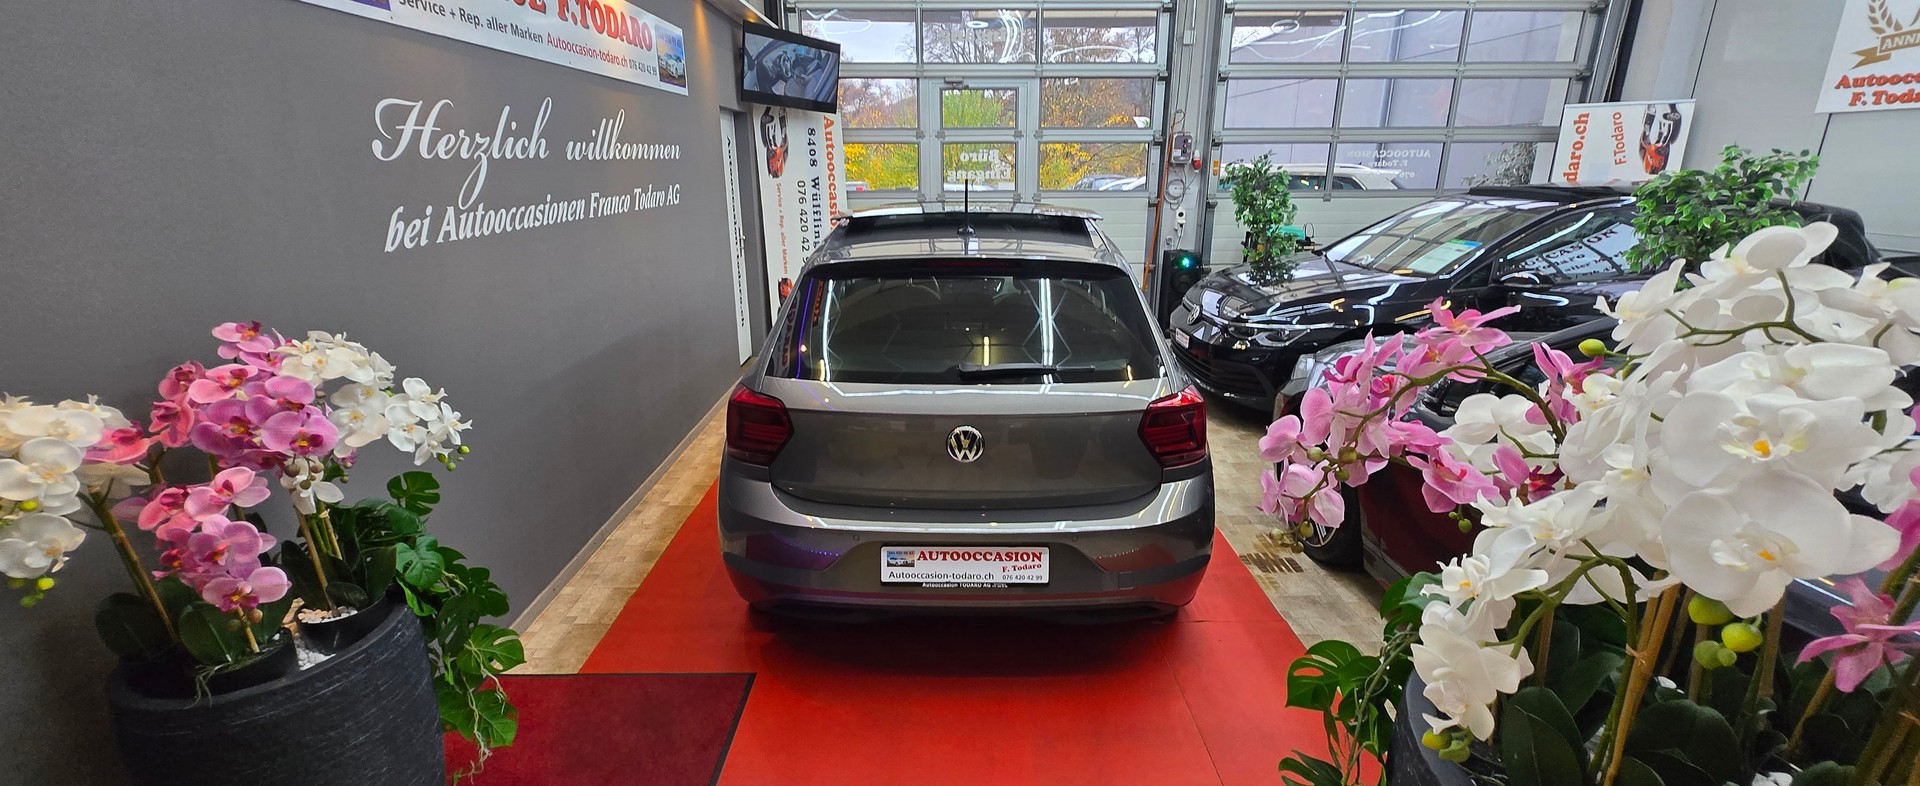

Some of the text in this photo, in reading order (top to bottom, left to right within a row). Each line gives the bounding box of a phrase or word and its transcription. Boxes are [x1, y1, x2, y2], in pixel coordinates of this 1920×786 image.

[459, 7, 484, 29] Rep.
[486, 16, 508, 34] aller
[510, 23, 543, 44] Marken
[547, 32, 628, 67] Autooccasion-todaro.ch
[1848, 91, 1867, 106] F.
[807, 127, 817, 168] 8408
[1611, 112, 1627, 165] F.Todaro
[371, 96, 681, 210] Herzlich willkommen
[823, 114, 841, 231] Autooccasio
[797, 180, 807, 204] 076
[385, 183, 681, 252] bei Autooccasionen Franco Todaro AG
[799, 208, 809, 234] 420
[801, 237, 810, 252] 42
[917, 550, 1042, 562] AUTOOCCASION
[1012, 563, 1042, 572] Todaro
[888, 570, 994, 581] Autooccasion-todaro.ch
